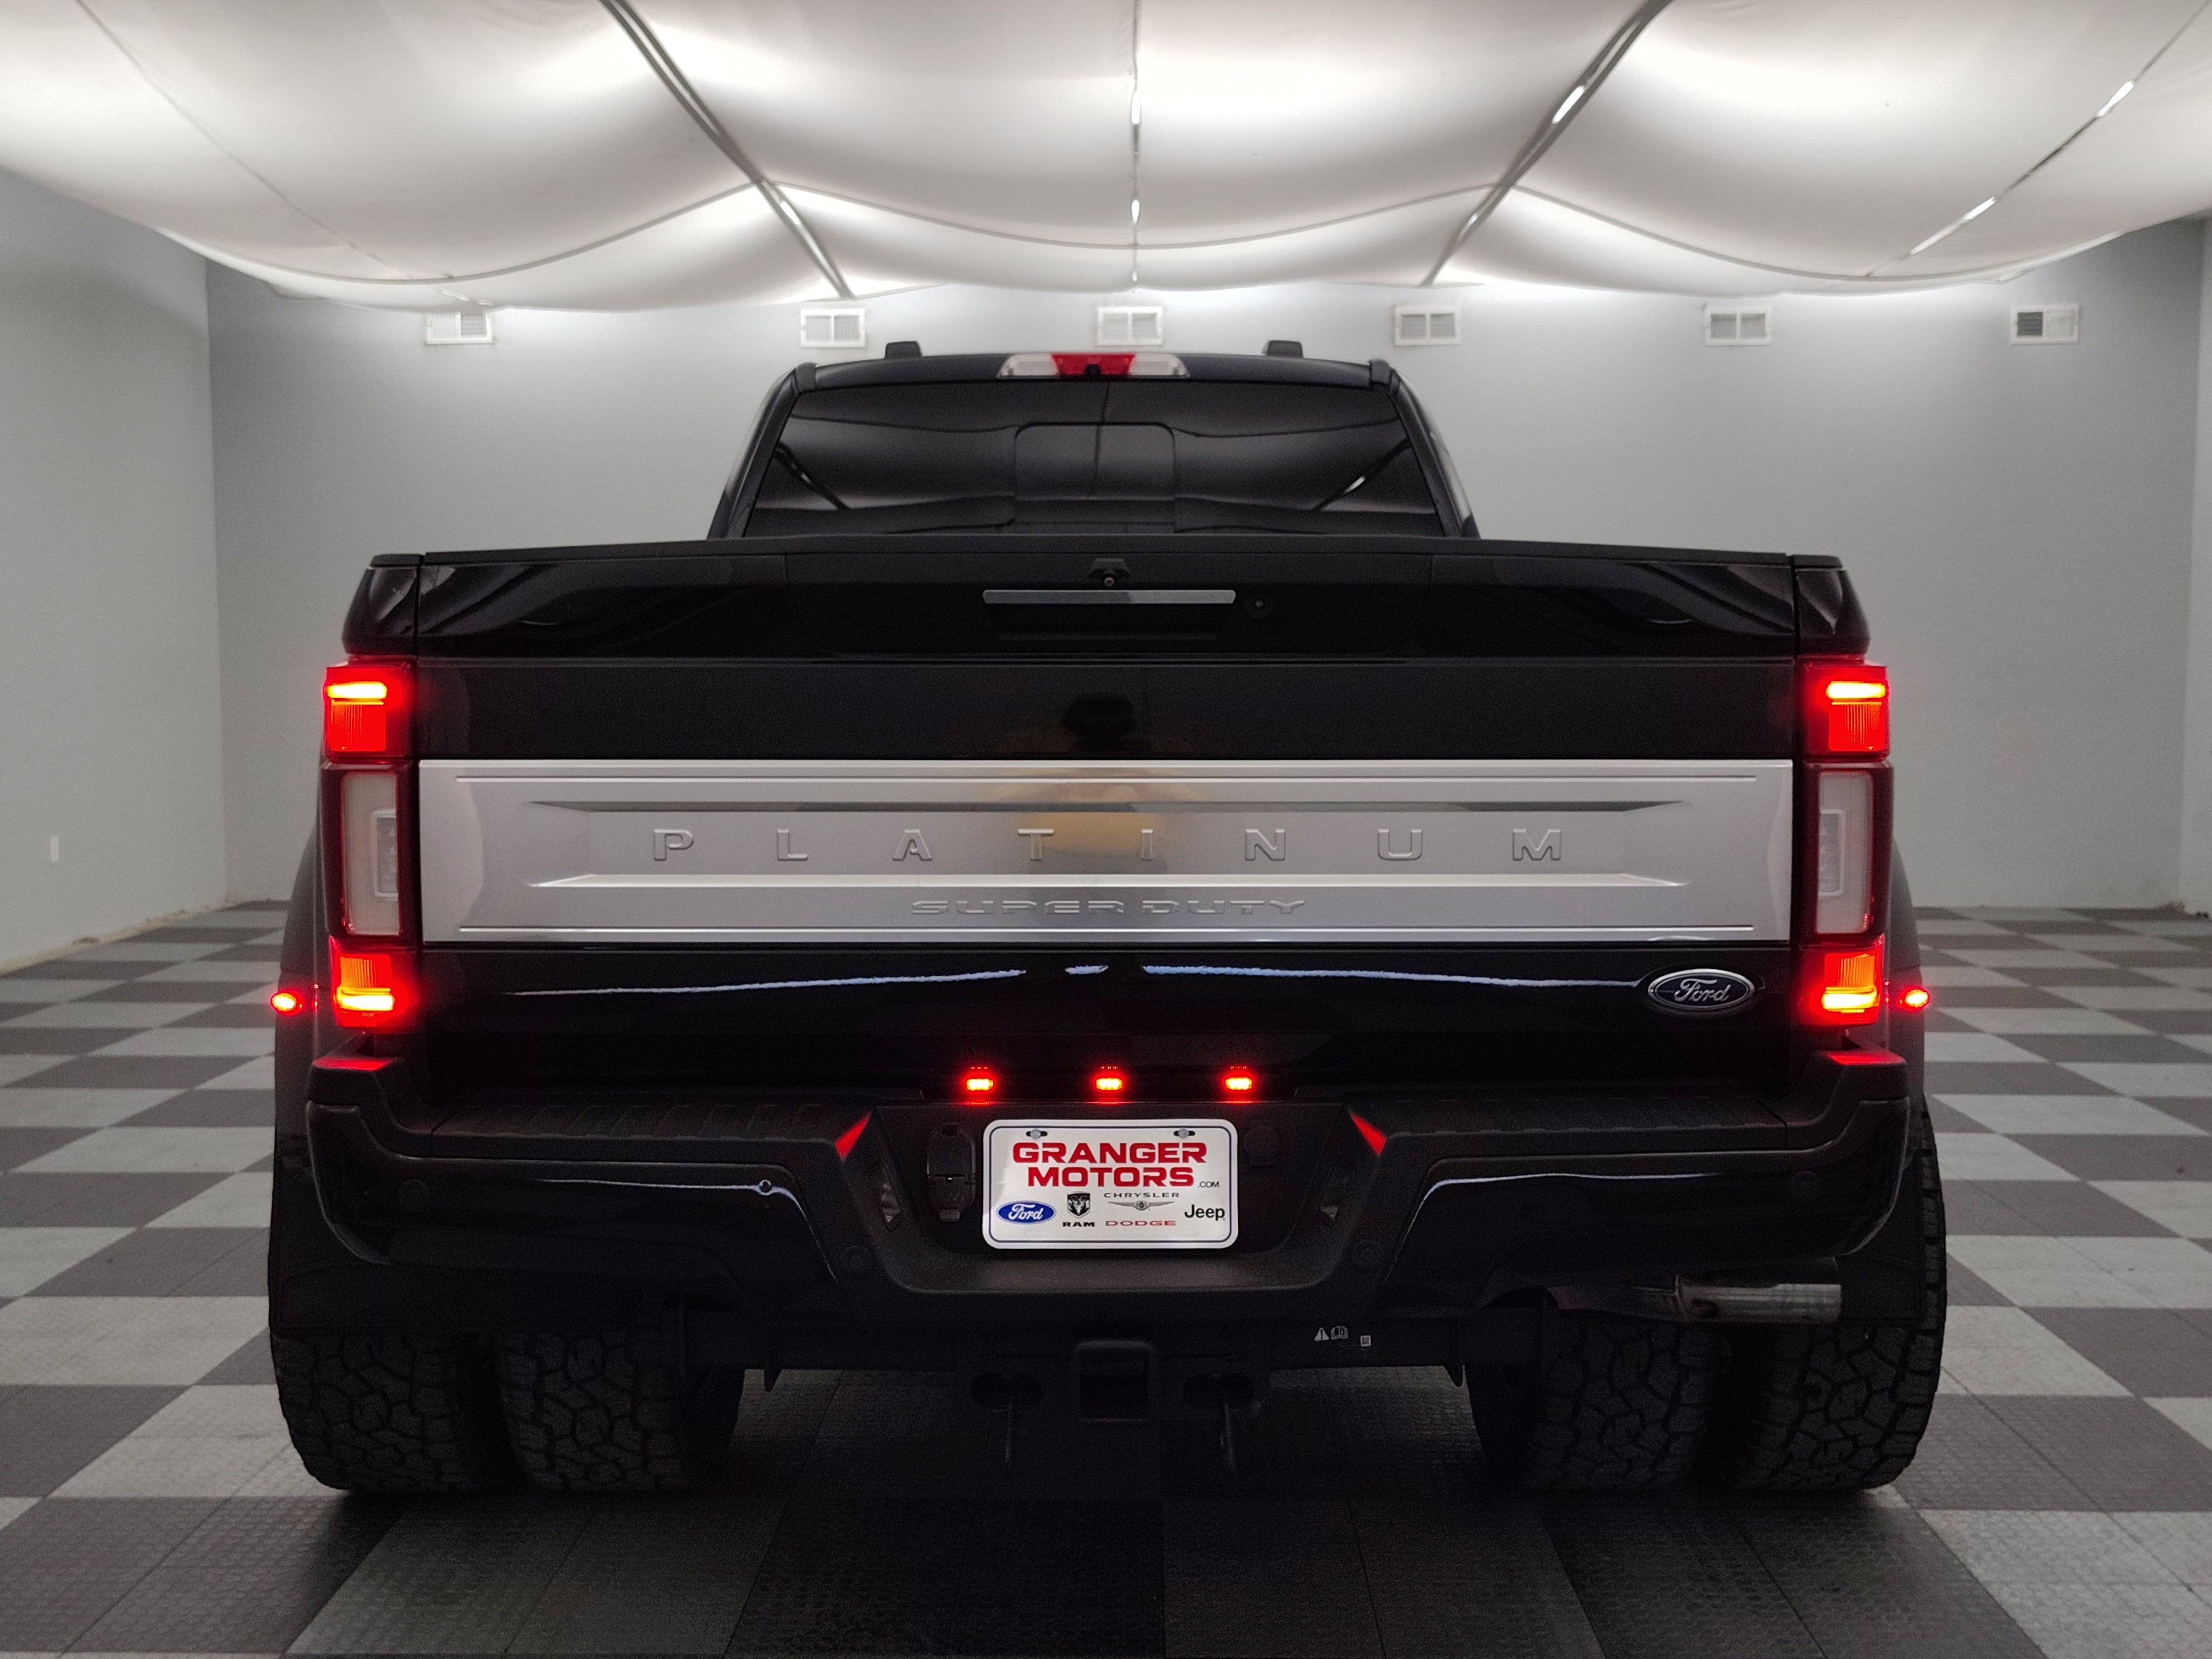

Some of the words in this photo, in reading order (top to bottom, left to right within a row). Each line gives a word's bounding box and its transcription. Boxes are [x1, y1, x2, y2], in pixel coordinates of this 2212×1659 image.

[653, 828, 1562, 861] PLATINUM
[912, 900, 1124, 914] SUPER
[1142, 900, 1305, 914] DUTY
[1674, 978, 1731, 1002] Ford
[1013, 1142, 1207, 1163] GRANGER
[1028, 1166, 1194, 1187] MOTORS
[1008, 1203, 1044, 1220] Ford
[1184, 1204, 1225, 1222] Jeep
